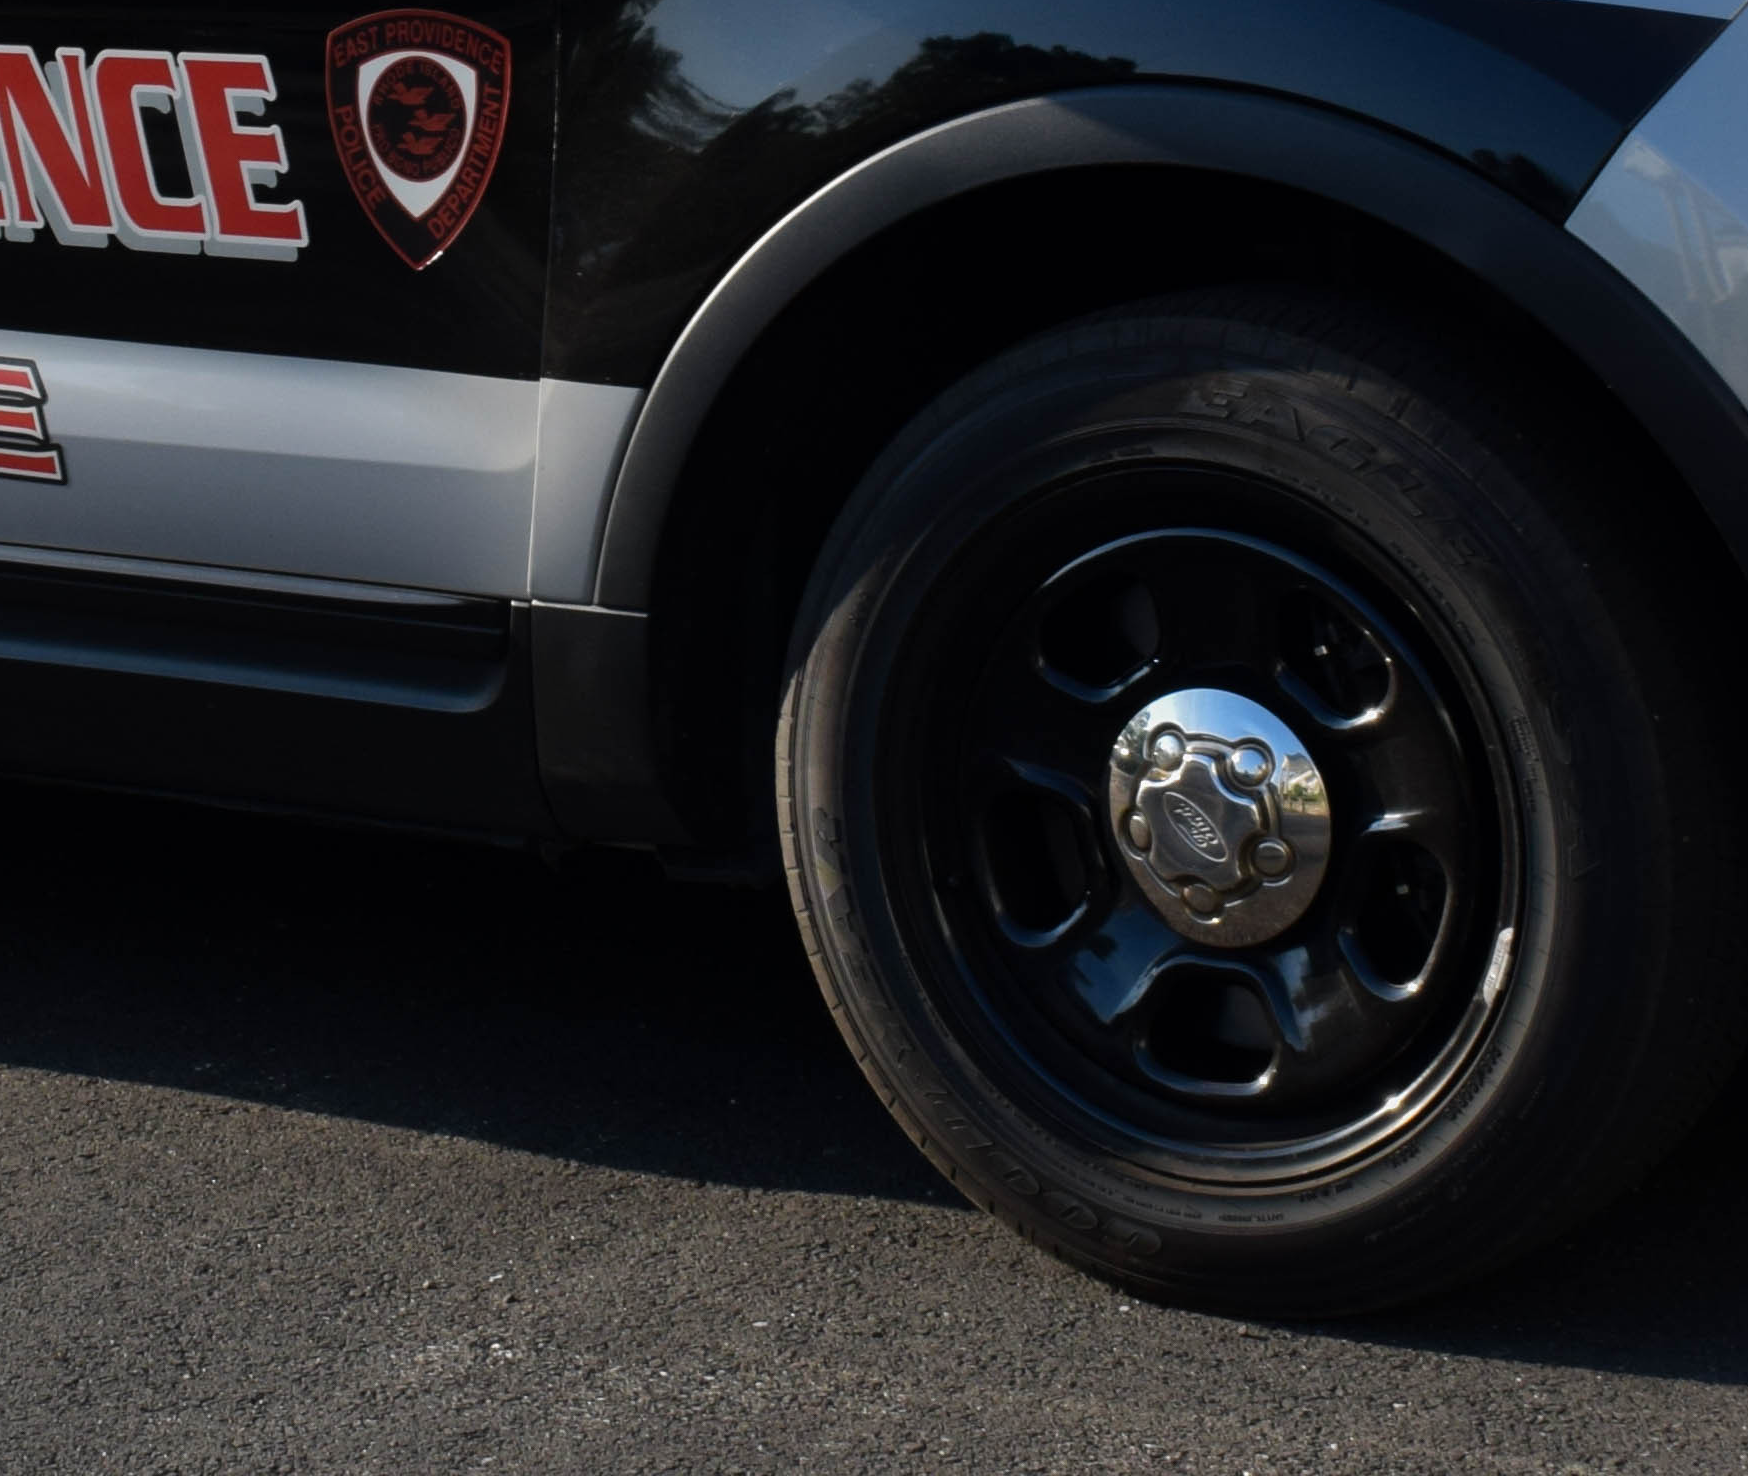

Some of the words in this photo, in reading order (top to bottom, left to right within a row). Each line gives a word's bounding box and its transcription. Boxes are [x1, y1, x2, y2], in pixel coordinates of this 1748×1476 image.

[333, 25, 379, 69] EAST
[384, 20, 504, 76] PROVIDENCE
[335, 103, 387, 212] POLICE
[425, 81, 502, 240] DEPARTMENT
[1172, 802, 1220, 850] Ford
